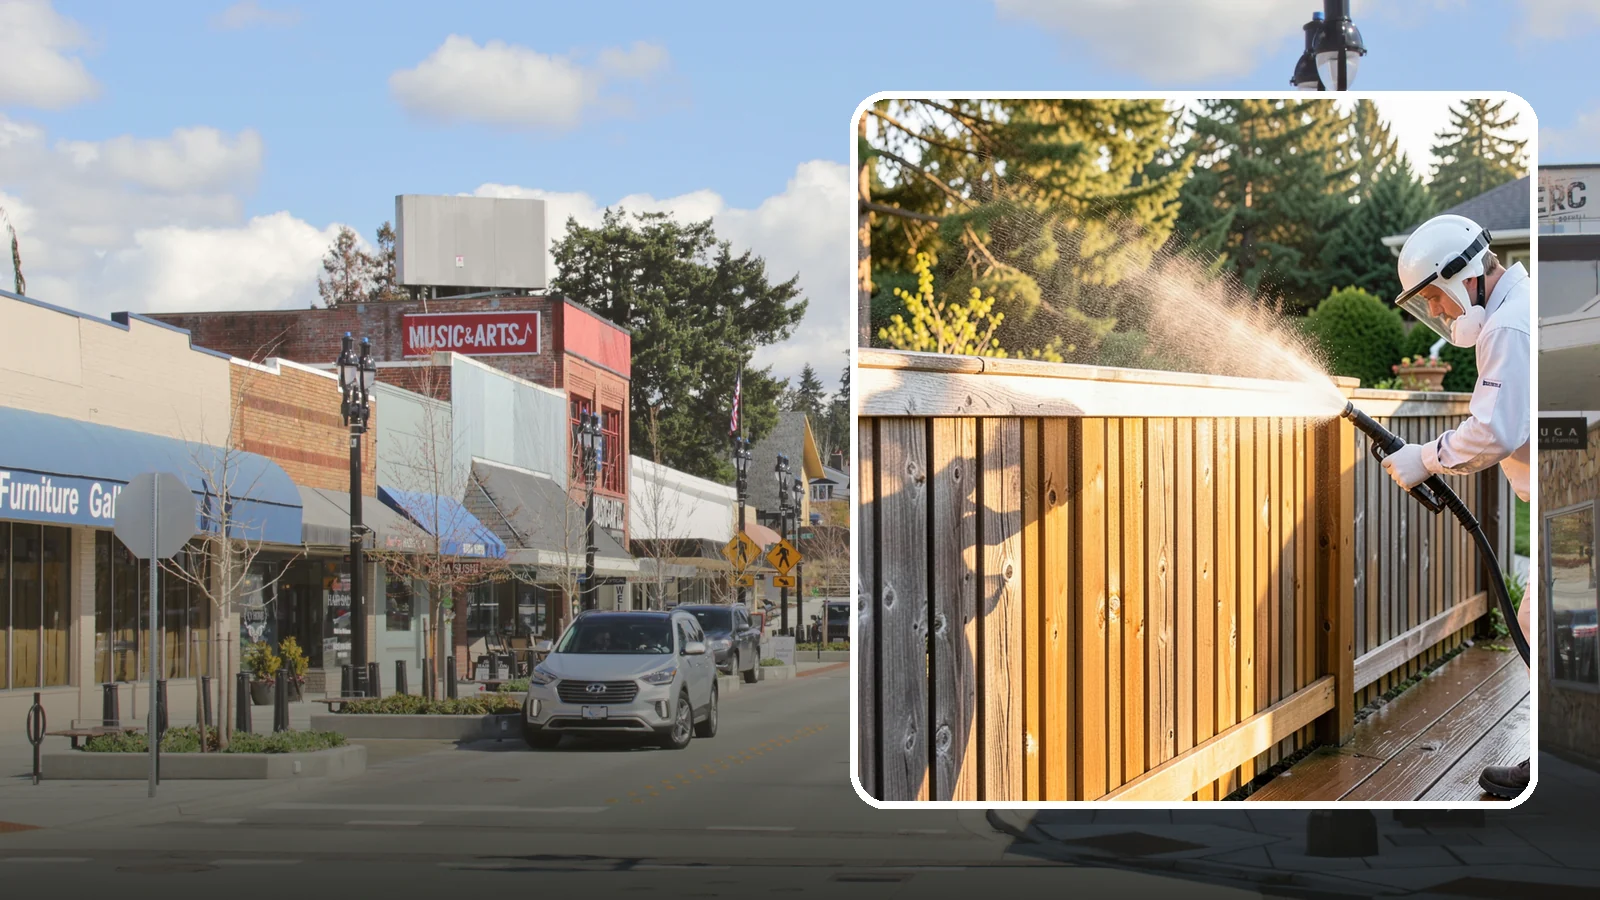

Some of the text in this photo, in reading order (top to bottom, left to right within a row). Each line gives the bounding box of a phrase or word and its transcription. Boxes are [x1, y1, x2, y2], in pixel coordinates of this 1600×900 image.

[1540, 427, 1577, 437] UGA
[0, 471, 122, 519] Furniture Gal
[454, 563, 480, 574] SUSHI
